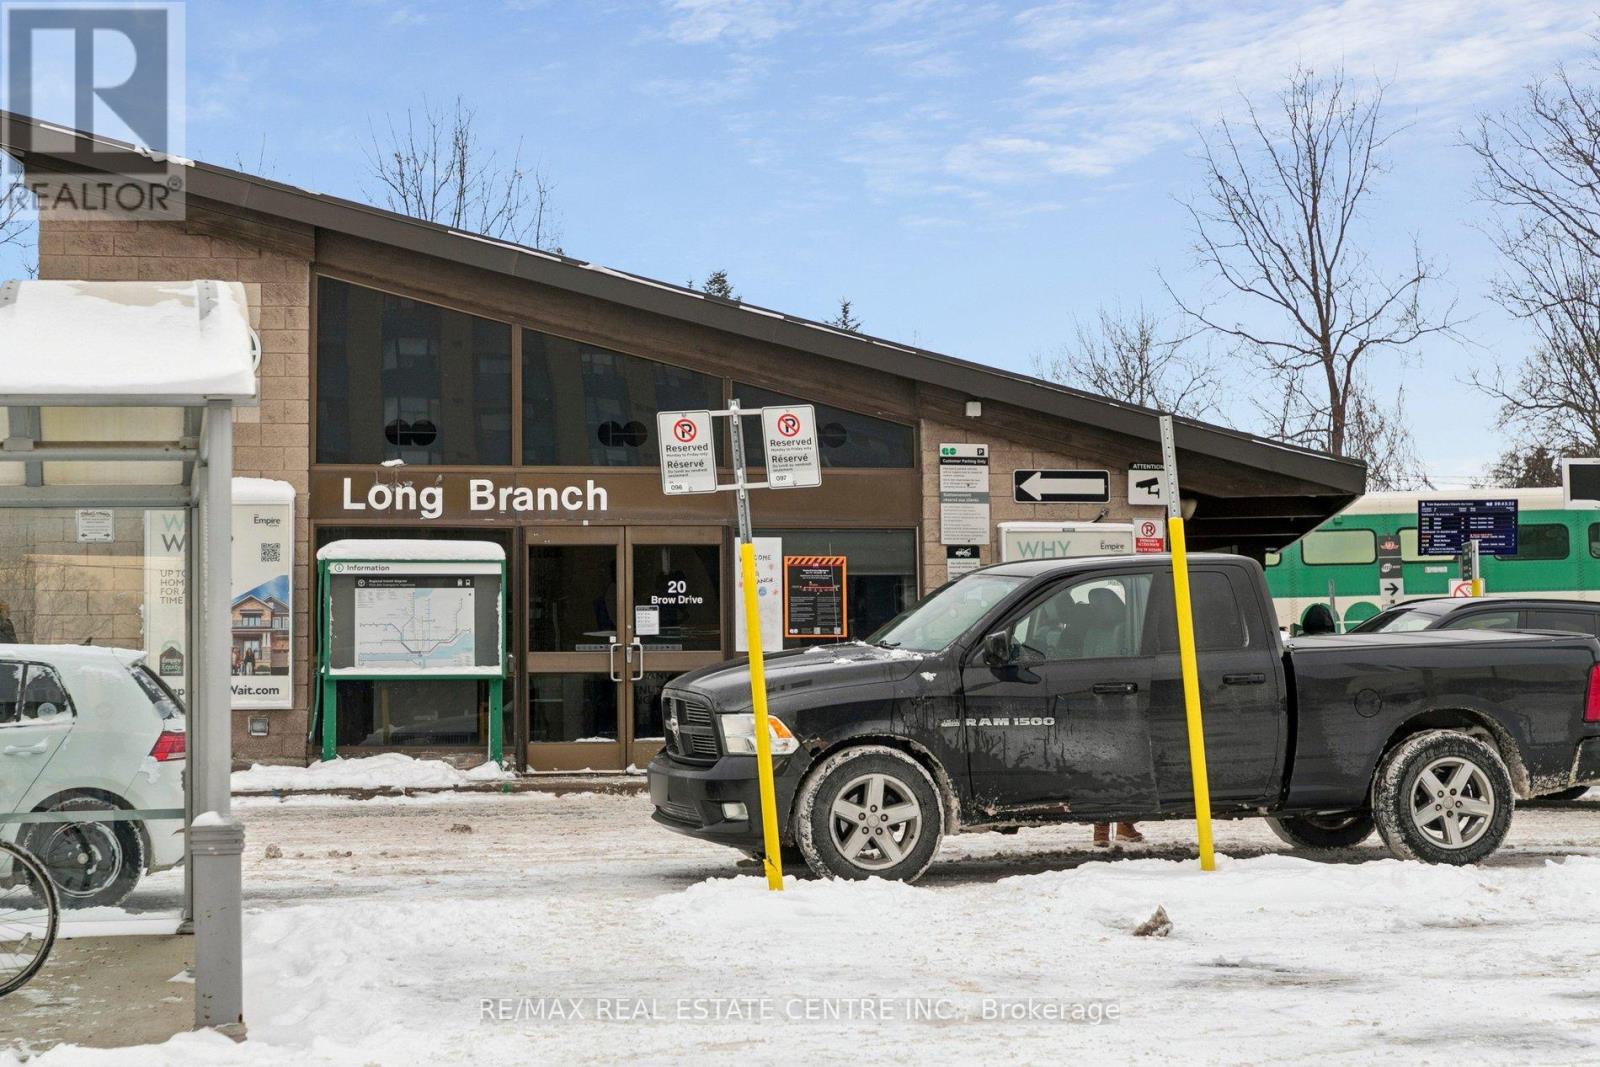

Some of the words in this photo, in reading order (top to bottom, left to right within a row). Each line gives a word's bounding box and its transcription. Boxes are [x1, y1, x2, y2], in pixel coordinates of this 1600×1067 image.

[770, 437, 812, 447] Reserved
[665, 443, 709, 453] Reserved
[771, 453, 808, 463] Réservé
[667, 459, 704, 469] Réservé
[342, 478, 444, 519] Long
[469, 479, 608, 511] Branch
[253, 516, 281, 526] Empire
[1017, 540, 1071, 559] WHY
[1100, 542, 1124, 551] Empire
[667, 580, 687, 593] 20
[651, 595, 676, 604] Brow
[678, 595, 703, 604] Drive
[966, 717, 1010, 727] RAM
[1013, 717, 1056, 727] 1500
